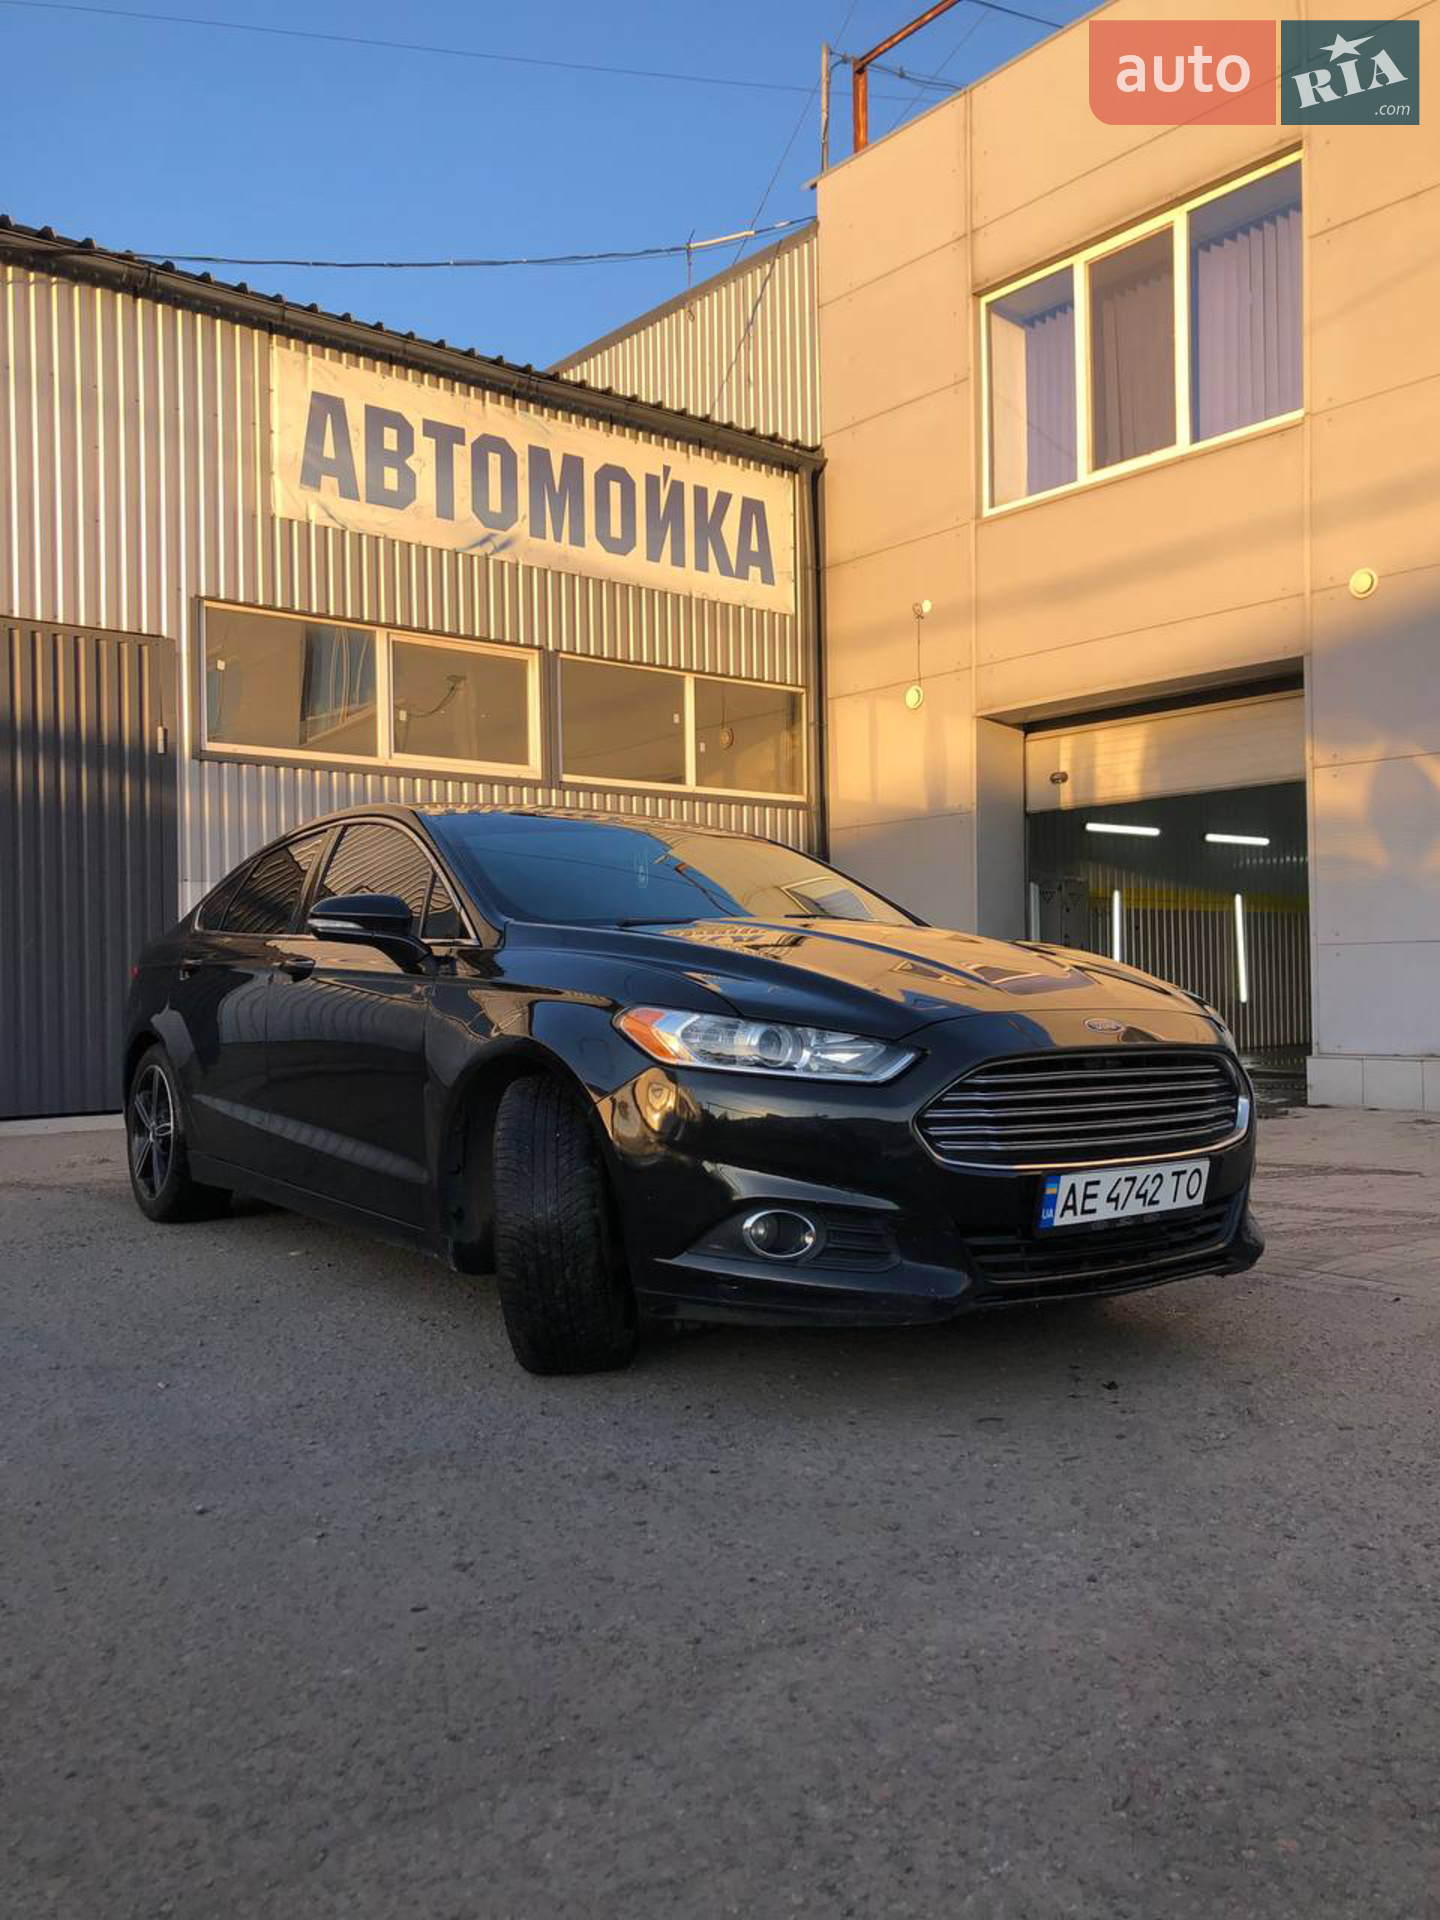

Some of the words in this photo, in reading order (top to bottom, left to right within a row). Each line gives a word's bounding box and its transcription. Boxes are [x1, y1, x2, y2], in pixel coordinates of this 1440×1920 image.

[300, 390, 776, 586] АВТОМОЙКА
[1059, 1179, 1101, 1218] AE
[1106, 1173, 1164, 1211] 4742
[1171, 1168, 1203, 1203] TO
